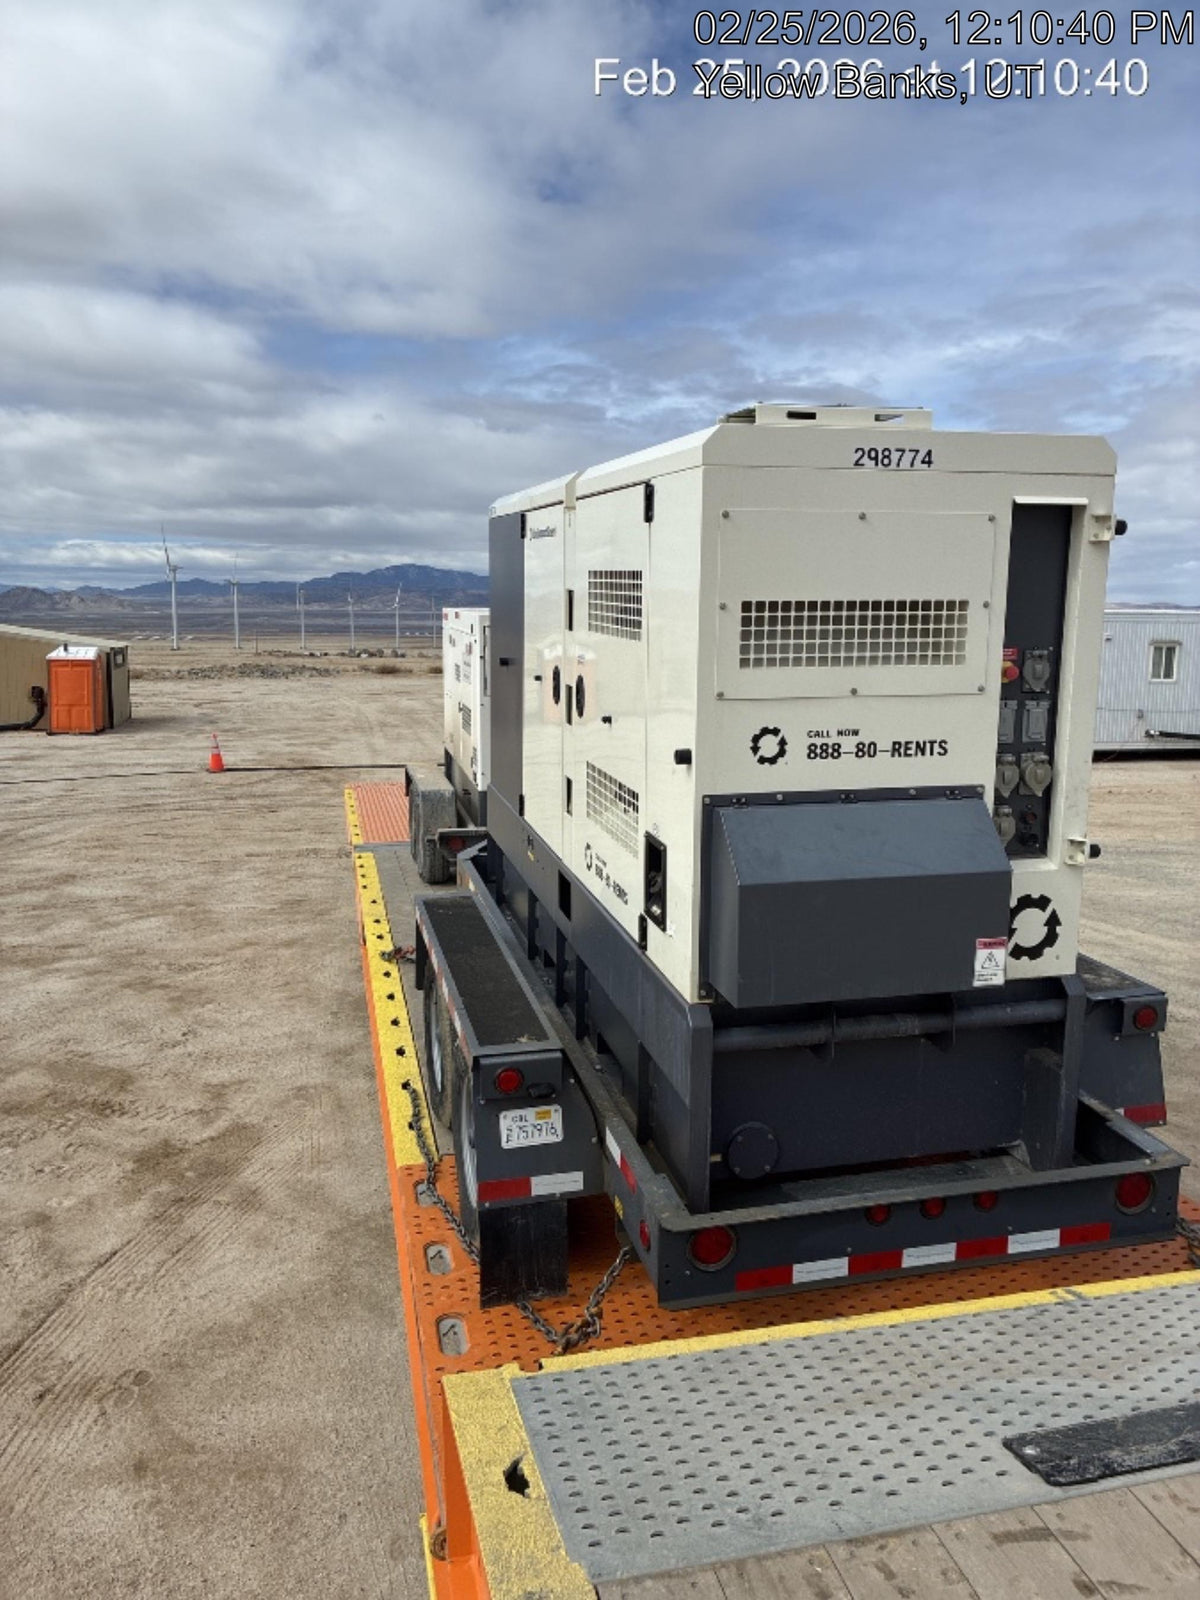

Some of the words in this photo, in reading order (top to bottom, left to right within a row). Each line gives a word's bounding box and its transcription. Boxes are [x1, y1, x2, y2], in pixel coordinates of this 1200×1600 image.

[853, 447, 934, 468] 298774
[807, 730, 832, 738] CALL
[837, 729, 860, 737] NOW
[806, 740, 949, 760] 888-80-RENTS
